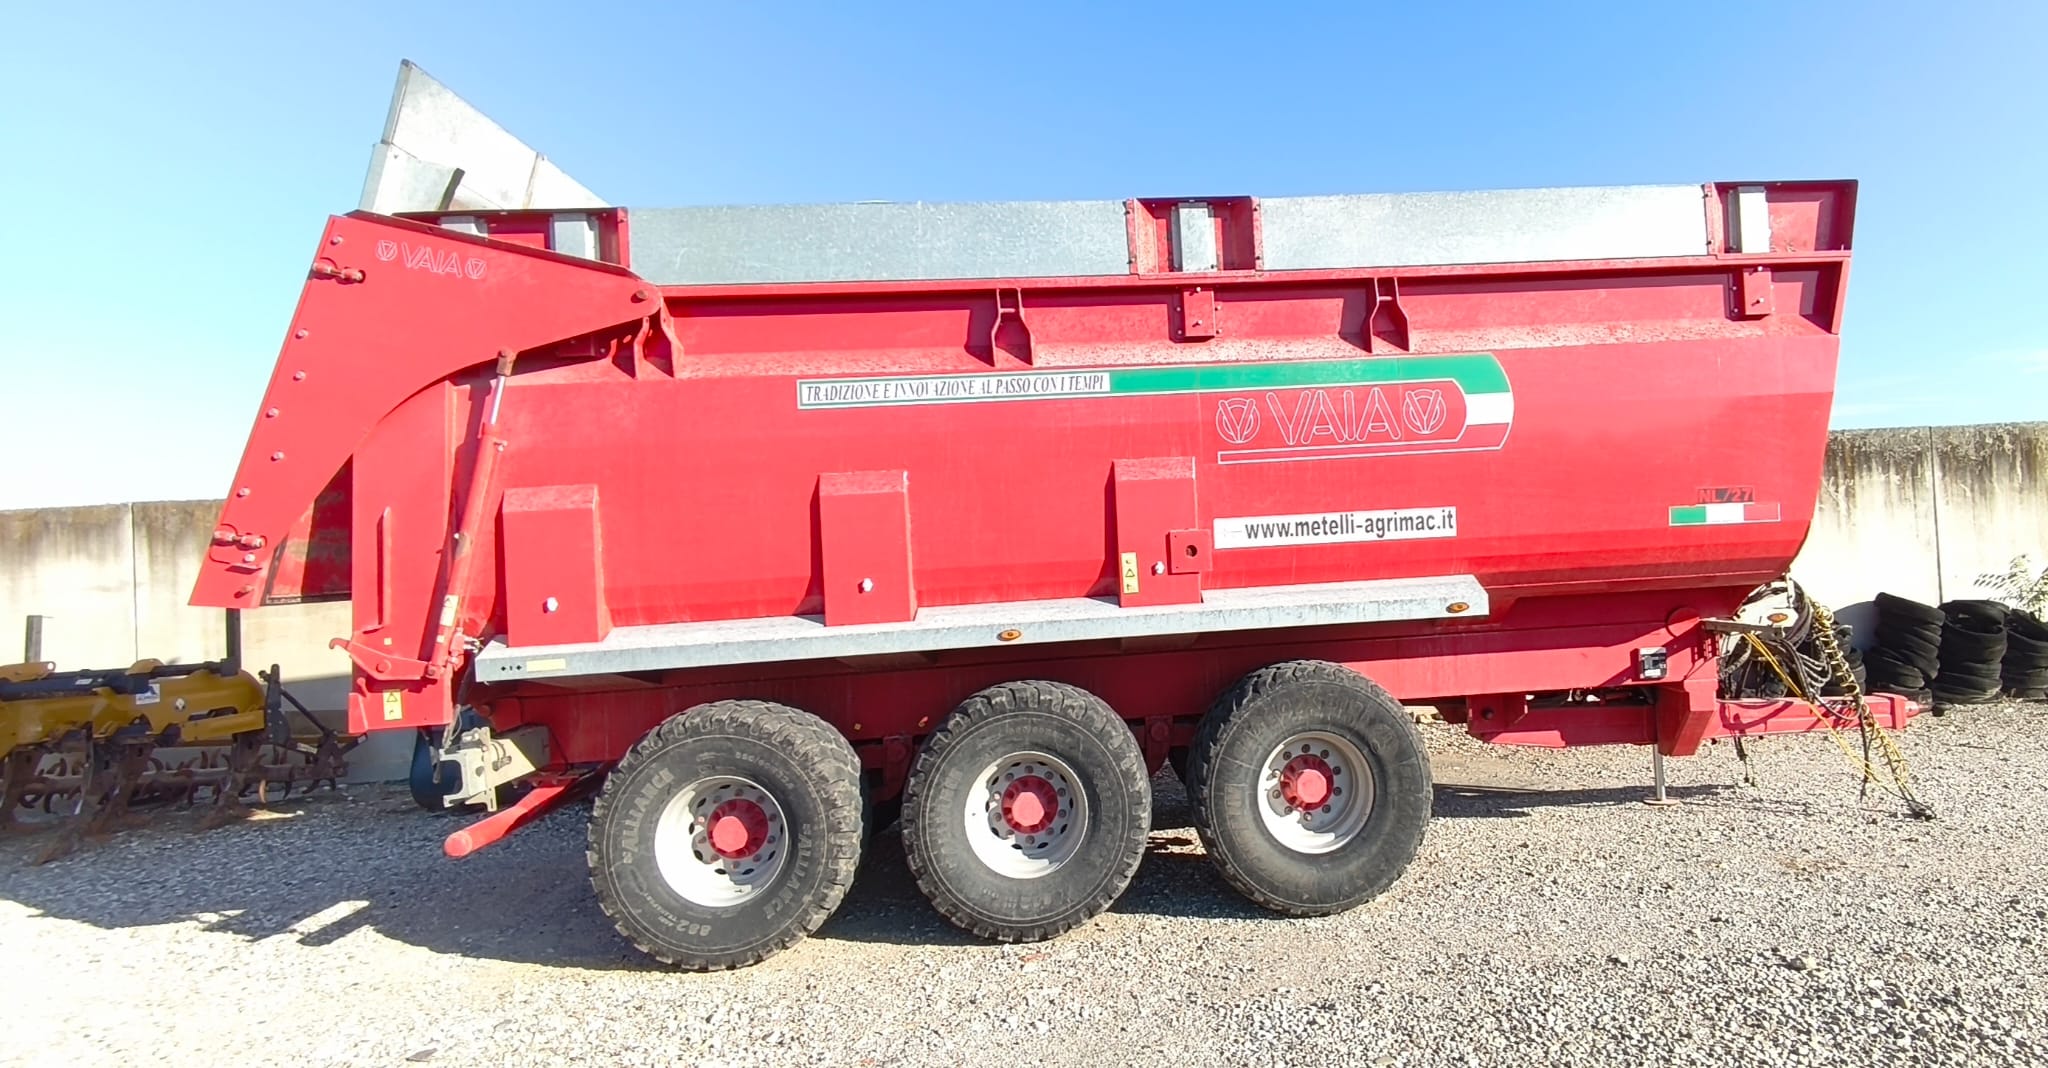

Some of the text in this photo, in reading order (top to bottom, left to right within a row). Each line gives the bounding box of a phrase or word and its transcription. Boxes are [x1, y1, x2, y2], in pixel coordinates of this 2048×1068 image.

[401, 242, 462, 278] VAIA
[806, 374, 1105, 402] TRADIZIONE E INNOVAZIONE AL PASSO CON I TEMPI
[1266, 387, 1401, 445] VAIA
[1244, 509, 1454, 539] www.metelli-agrimac.it
